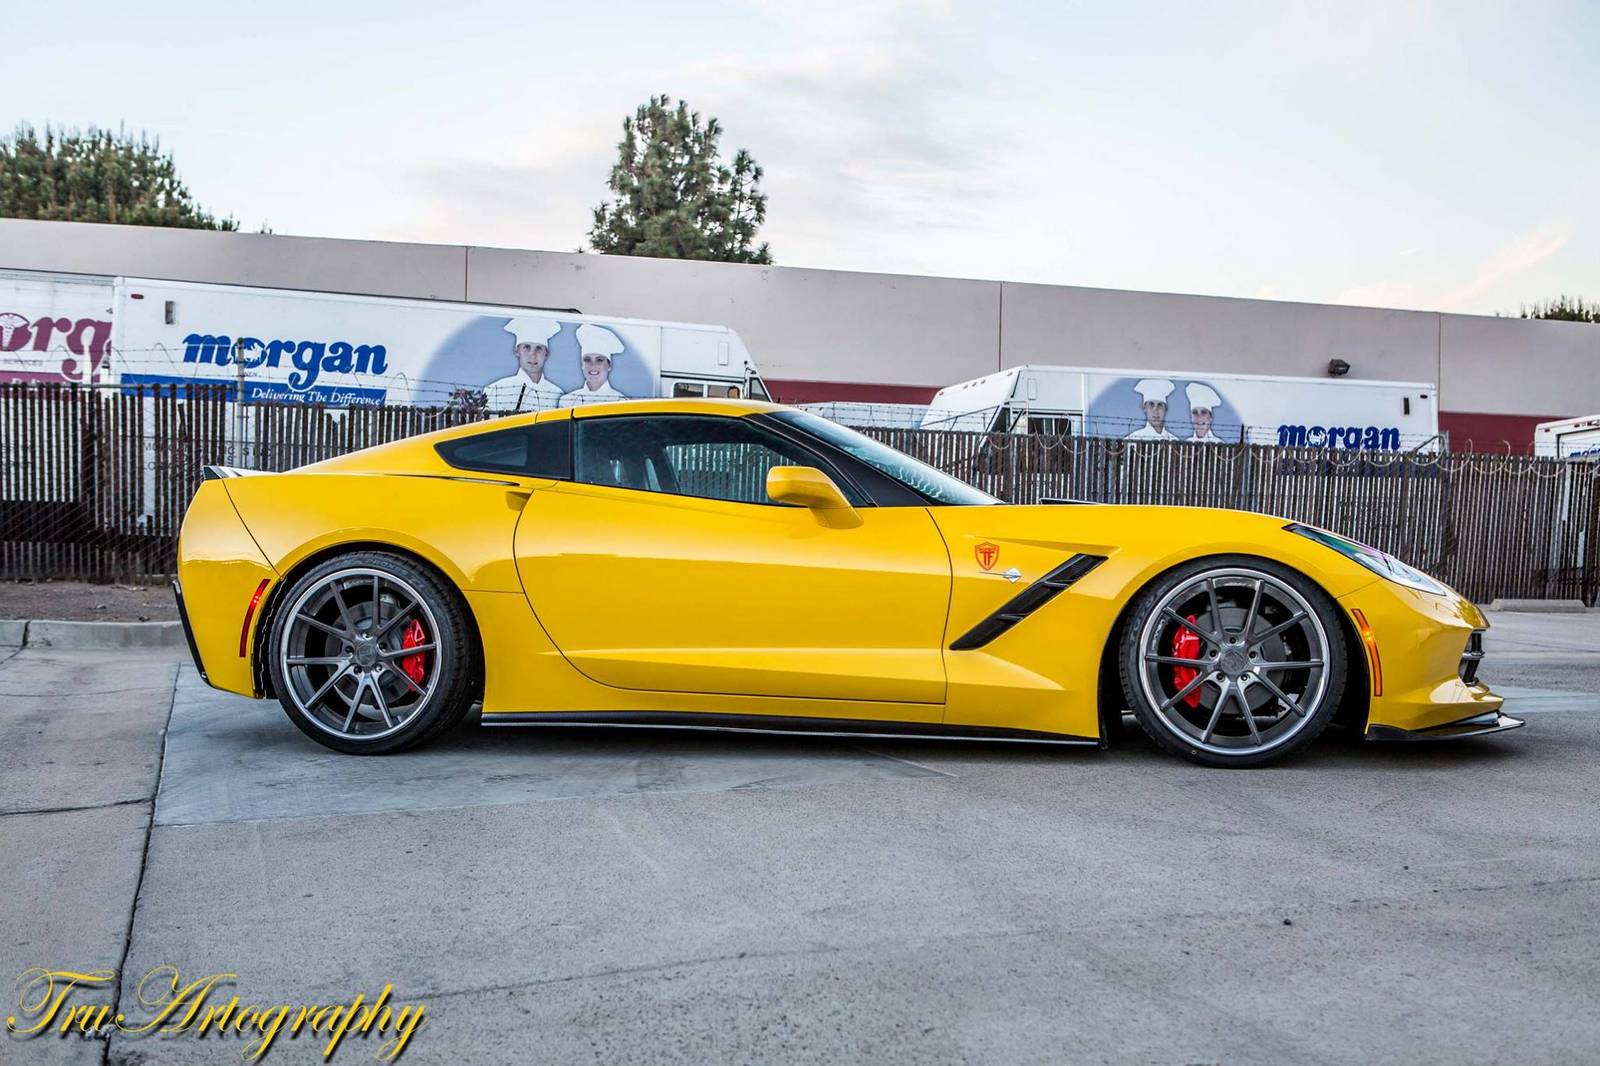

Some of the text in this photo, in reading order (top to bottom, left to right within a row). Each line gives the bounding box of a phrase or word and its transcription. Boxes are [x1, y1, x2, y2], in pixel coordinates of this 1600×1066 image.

[0, 312, 112, 383] org
[182, 332, 388, 393] morgan
[251, 386, 382, 406] Delivering The Difference
[1277, 424, 1401, 454] morgan
